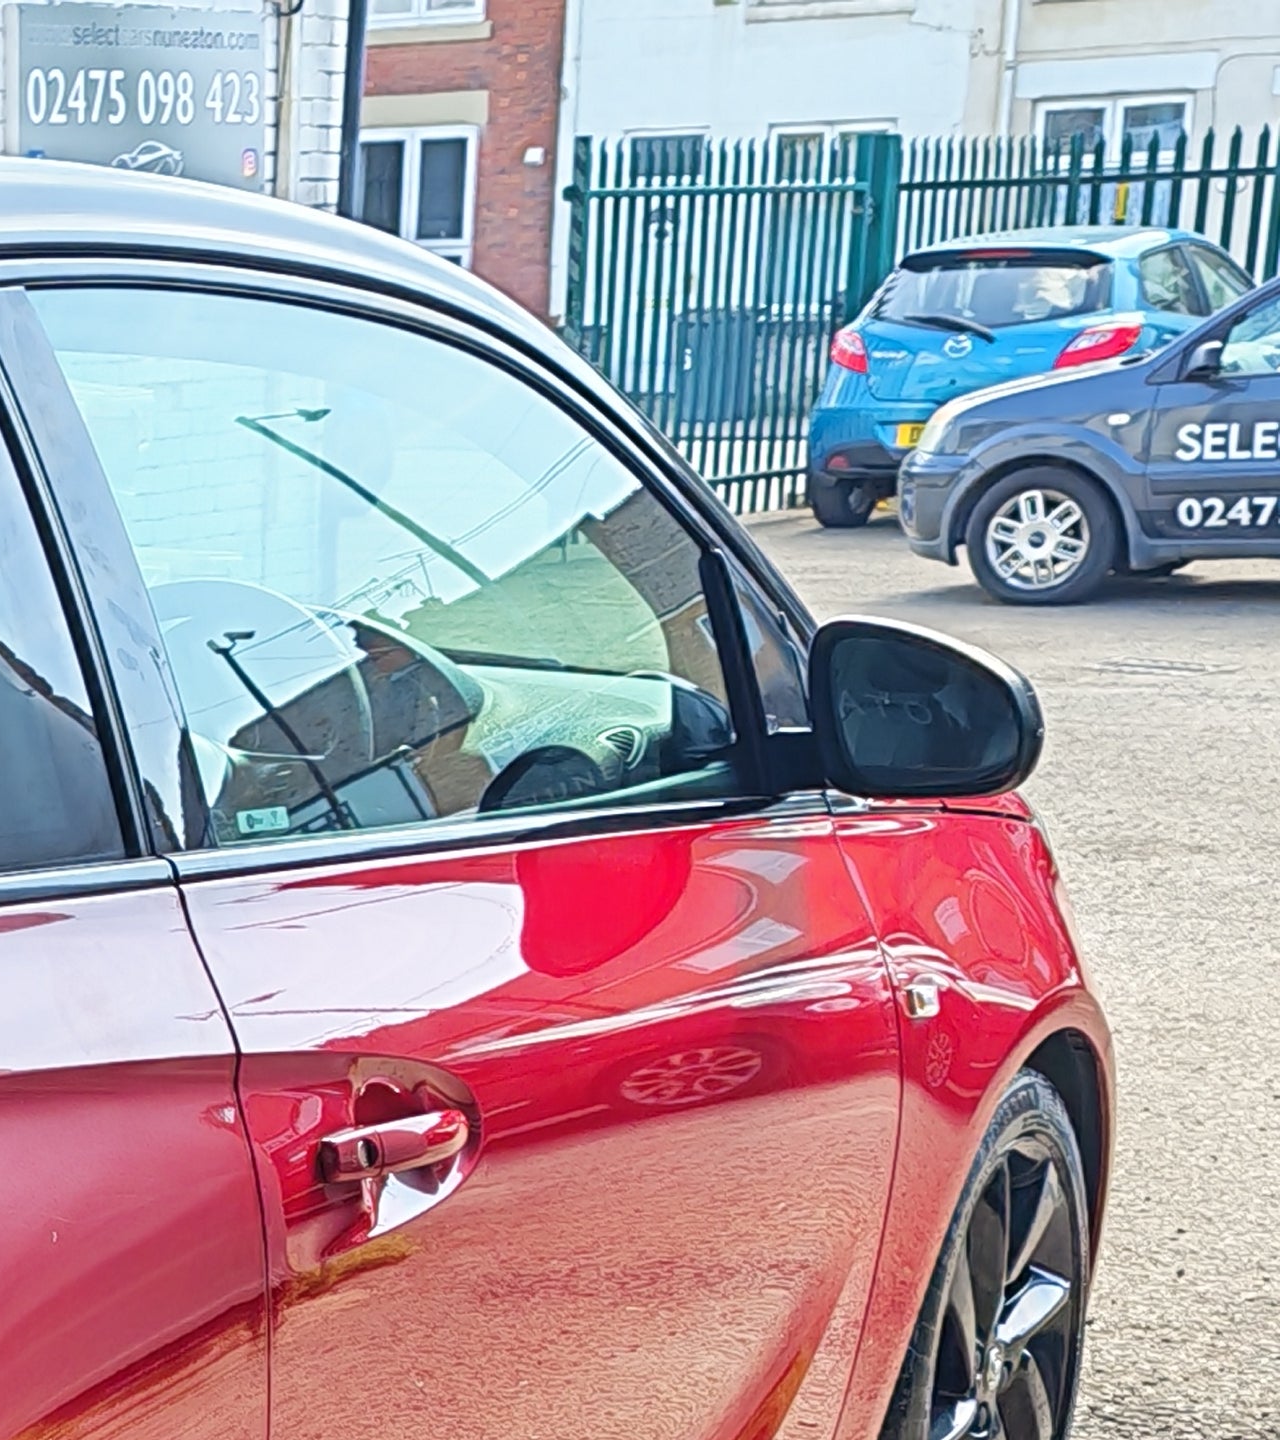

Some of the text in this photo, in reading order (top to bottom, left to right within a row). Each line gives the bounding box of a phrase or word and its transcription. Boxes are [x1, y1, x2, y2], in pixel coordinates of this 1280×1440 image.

[26, 67, 261, 125] 02475 098 423
[1175, 422, 1280, 461] SELE
[1177, 496, 1280, 528] 0247
